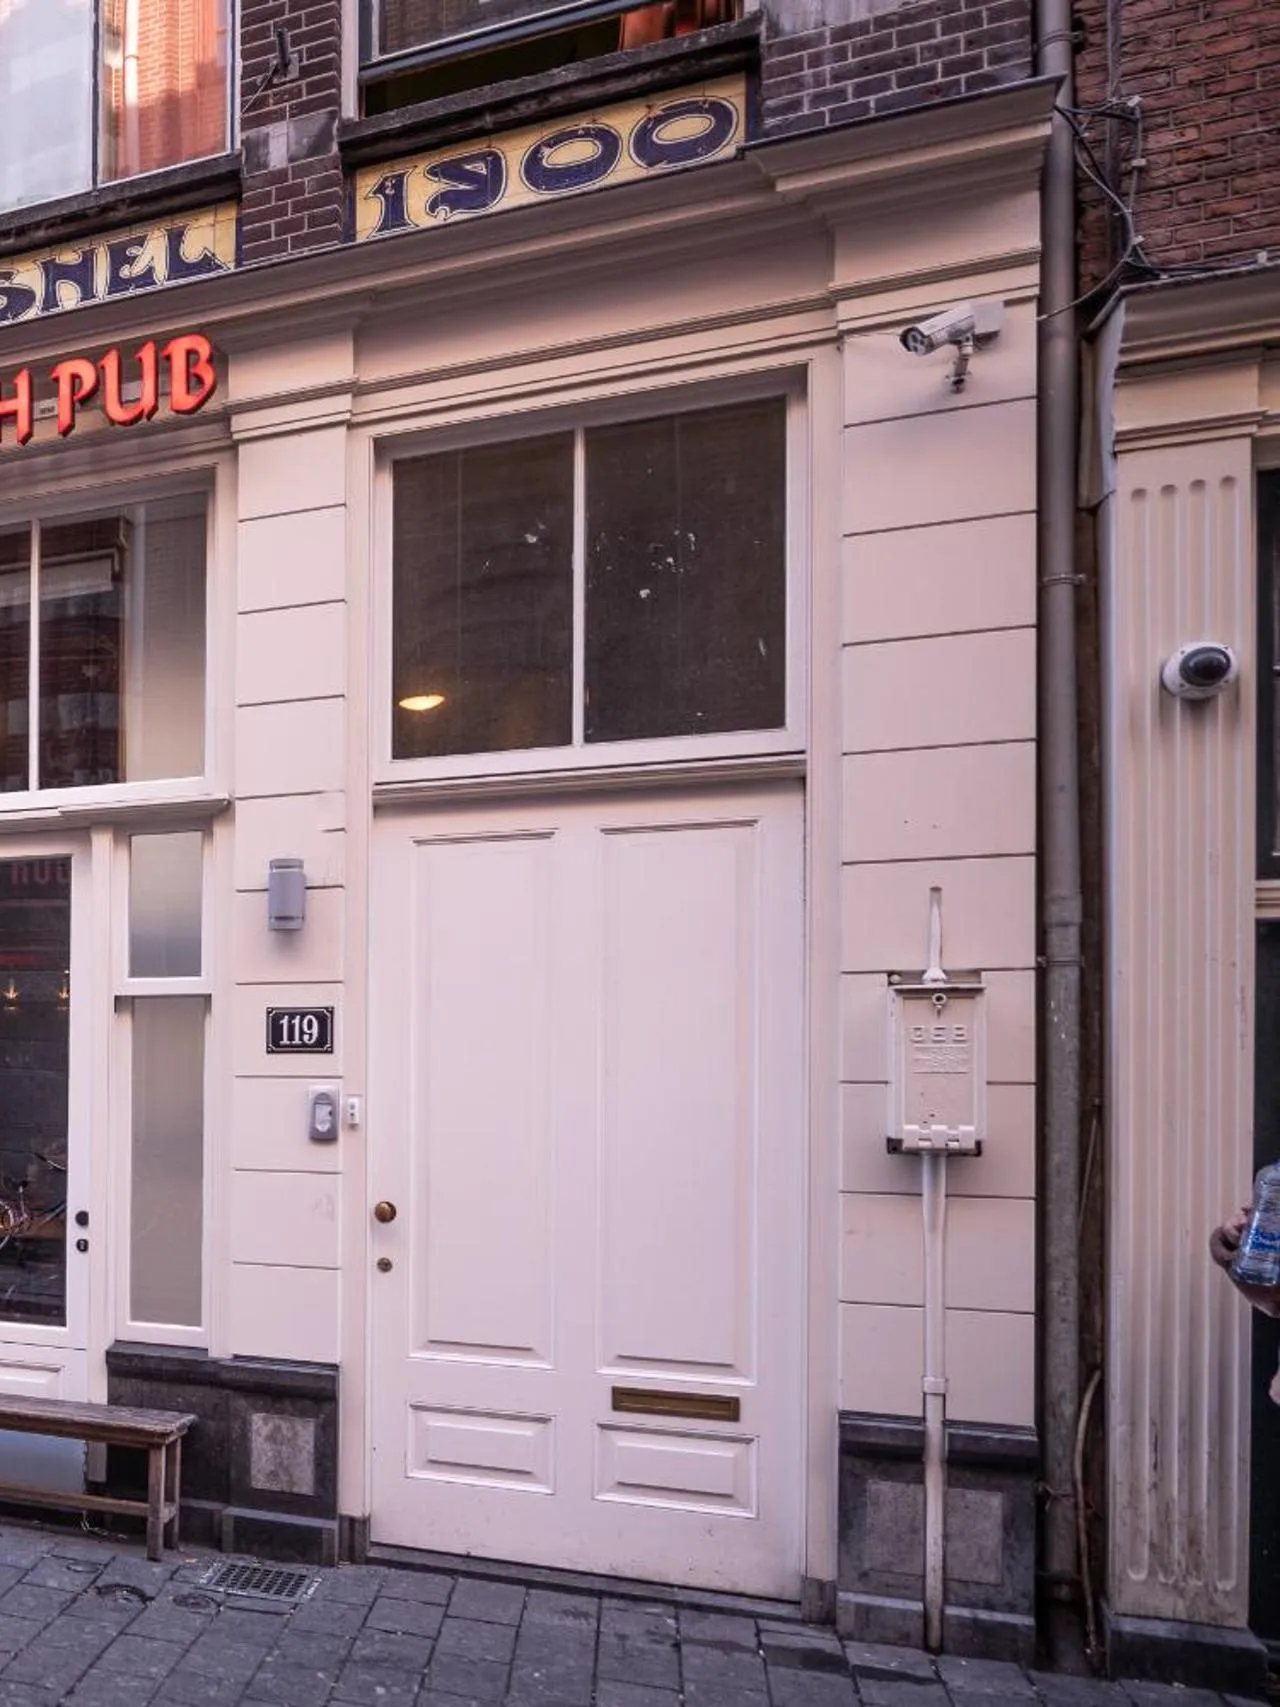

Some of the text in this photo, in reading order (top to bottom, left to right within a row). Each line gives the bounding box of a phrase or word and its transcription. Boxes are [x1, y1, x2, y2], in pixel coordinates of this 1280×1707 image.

[365, 96, 739, 239] 1900
[51, 334, 217, 437] PUB
[279, 1014, 319, 1045] 119
